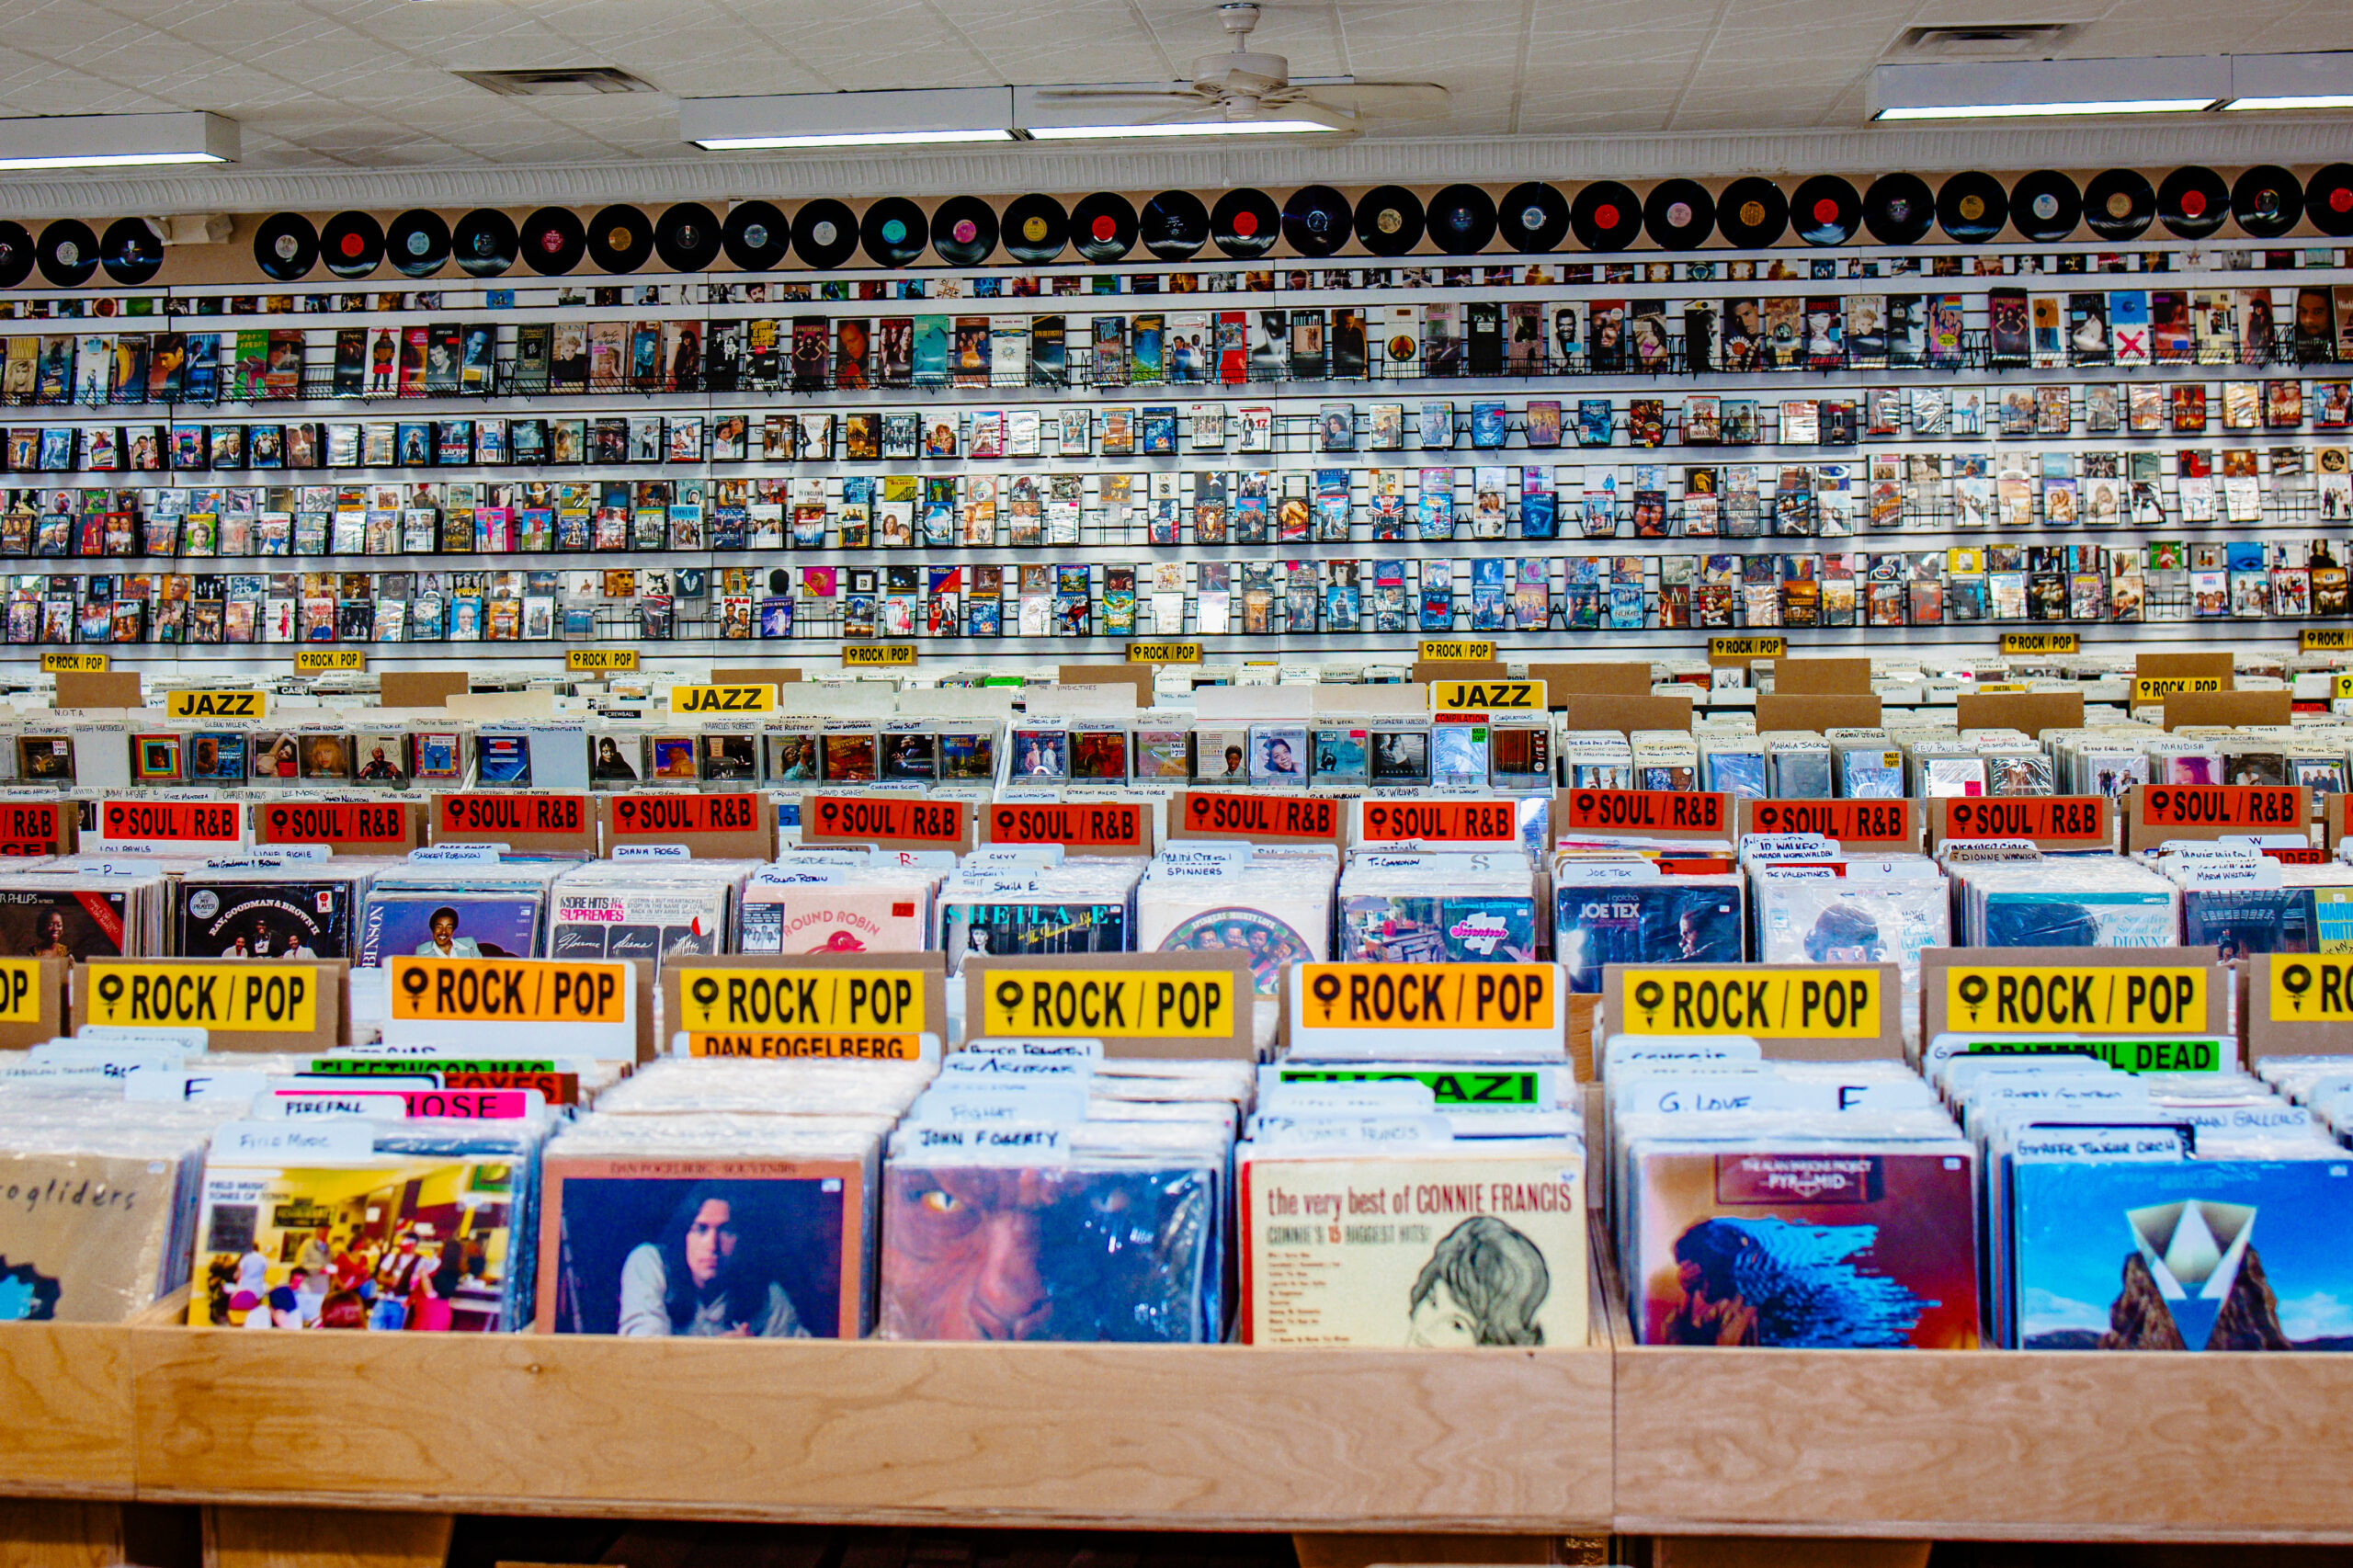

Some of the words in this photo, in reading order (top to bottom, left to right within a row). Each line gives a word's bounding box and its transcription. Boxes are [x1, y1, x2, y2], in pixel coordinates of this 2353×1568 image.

[1255, 419, 1267, 428] 17
[1726, 640, 1752, 653] ROCK
[1760, 640, 1779, 653] POP
[2018, 635, 2045, 649] ROCK
[2052, 636, 2072, 649] POP
[2318, 631, 2344, 645] ROCK
[307, 654, 333, 666] ROCK
[341, 653, 357, 665] POP
[583, 653, 607, 665] ROCK
[615, 653, 631, 665] POP
[859, 648, 883, 661] ROCK
[892, 648, 908, 661] POP
[1144, 646, 1169, 659] ROCK
[1176, 646, 1194, 659] POP
[1437, 644, 1461, 657] ROCK
[1471, 644, 1488, 657] POP
[56, 656, 79, 668] ROCK
[86, 657, 102, 669] POP
[683, 688, 761, 710] JAZZ
[1448, 686, 1531, 707] JAZZ
[2154, 681, 2186, 698] ROCK
[178, 695, 254, 715] JAZZ
[1435, 713, 1490, 722] COMPILATIONS
[470, 800, 520, 827] SOUL
[538, 801, 577, 828] R&B
[641, 801, 692, 828] SOUL
[710, 799, 750, 826] R&B
[1214, 799, 1267, 829] SOUL
[1288, 803, 1329, 832] R&B
[1599, 795, 1654, 824] SOUL
[1674, 797, 1716, 825] R&B
[2174, 791, 2230, 822] SOUL
[2250, 793, 2293, 822] R&B
[14, 811, 51, 837] R&B
[129, 808, 177, 835] SOUL
[195, 809, 233, 836] R&B
[292, 810, 342, 837] SOUL
[359, 809, 398, 836] R&B
[843, 804, 894, 834] SOUL
[914, 807, 954, 835] R&B
[1019, 811, 1073, 839] SOUL
[1092, 812, 1132, 839] R&B
[1392, 809, 1446, 835] SOUL
[1466, 809, 1507, 836] R&B
[1782, 808, 1838, 835] SOUL
[1859, 807, 1901, 835] R&B
[1976, 805, 2032, 834] SOUL
[2052, 804, 2095, 834] R&B
[446, 851, 481, 859] ROBINSON
[654, 847, 680, 856] ROSS
[1167, 868, 1222, 876] SPINNERS
[1586, 869, 1608, 877] JOE
[1609, 869, 1631, 877] TEX
[225, 899, 273, 919] GOODMAN
[281, 902, 313, 928] BROWN
[561, 896, 586, 909] MORE
[588, 896, 608, 909] HITS
[1579, 903, 1609, 918] JOE
[1612, 903, 1641, 918] TEX
[560, 909, 624, 922] SUPREMES
[783, 911, 834, 937] ROUND
[835, 911, 881, 937] ROBIN
[946, 904, 1071, 925] SHEILA
[1091, 904, 1120, 925] E.
[362, 905, 384, 969] BINSON
[132, 975, 217, 1020] ROCK
[246, 976, 303, 1021] POP
[438, 969, 524, 1013] ROCK
[555, 972, 614, 1015] POP
[729, 978, 819, 1023] ROCK
[851, 979, 911, 1024] POP
[1351, 974, 1444, 1020] ROCK
[1478, 975, 1542, 1021] POP
[1998, 975, 2095, 1024] ROCK
[2129, 975, 2193, 1023] POP
[1034, 982, 1125, 1028] ROCK
[1159, 983, 1220, 1028] POP
[1675, 981, 1769, 1028] ROCK
[1803, 981, 1868, 1028] POP
[705, 1037, 752, 1057] DAN
[762, 1038, 904, 1059] FOGELBERG
[2137, 1044, 2211, 1070] DEAD
[185, 1078, 212, 1101] F
[1839, 1085, 1868, 1110] F
[286, 1101, 365, 1115] FIREFALL
[920, 1131, 963, 1147] JOHN
[976, 1131, 1058, 1147] FOGERTY
[1267, 1186, 1298, 1215] the
[1303, 1191, 1341, 1222] very
[1347, 1187, 1385, 1214] best
[1392, 1186, 1410, 1214] of
[1416, 1184, 1483, 1214] CONNIE
[1492, 1183, 1572, 1212] FRANCIS
